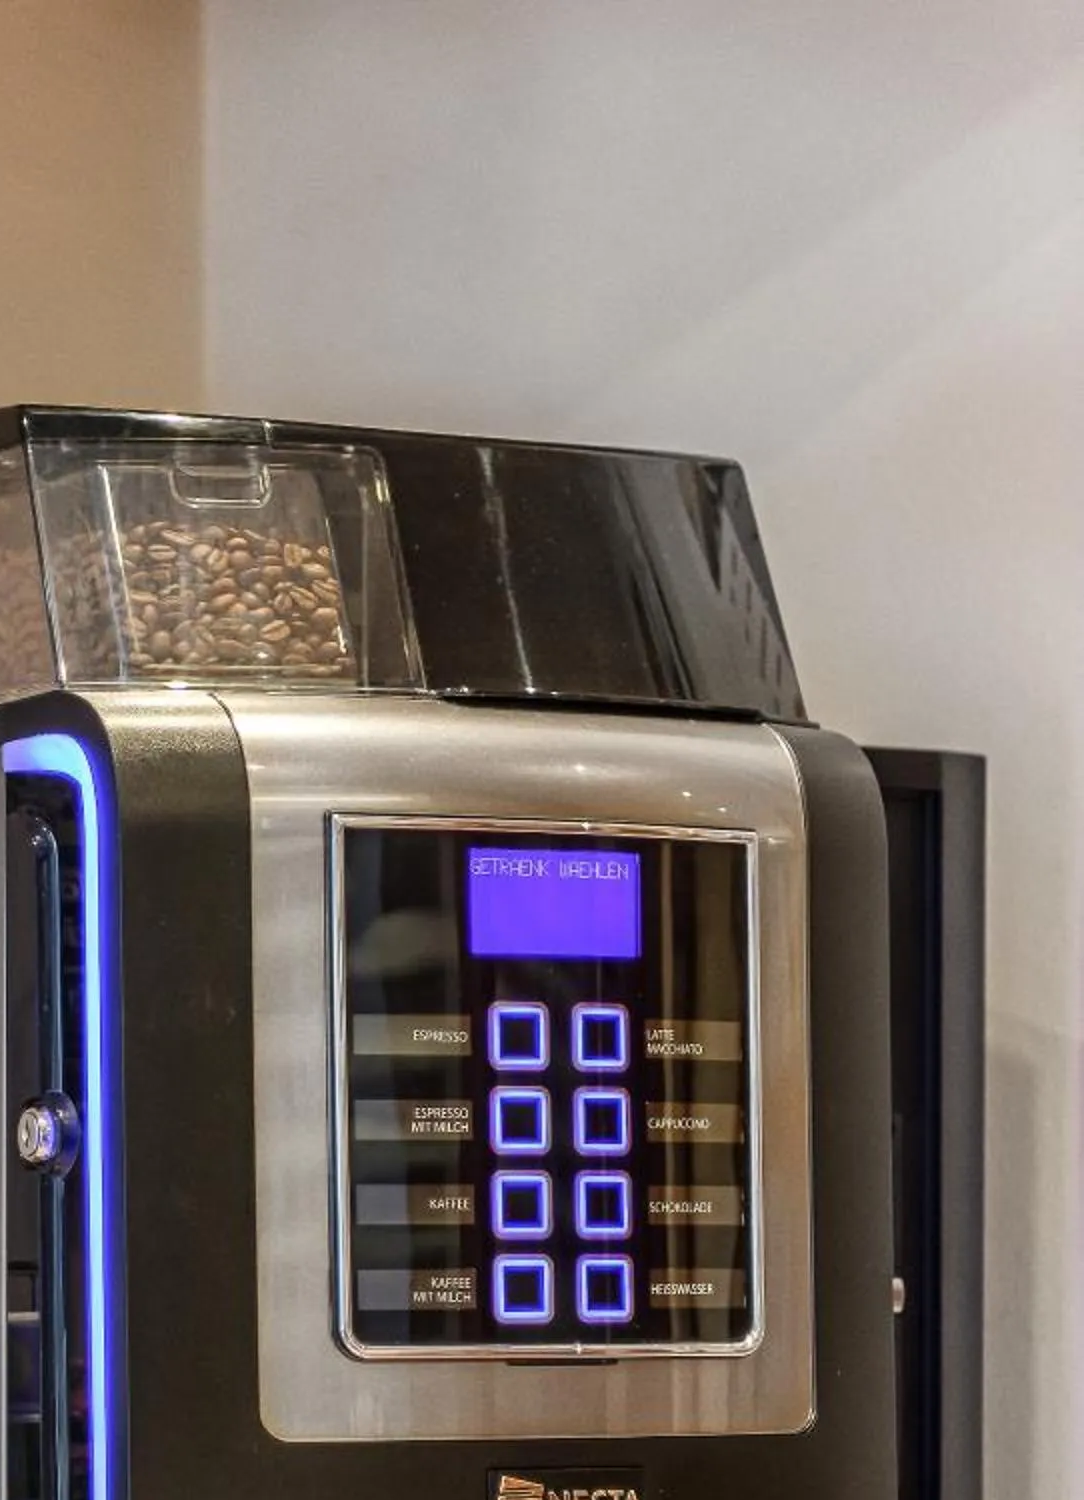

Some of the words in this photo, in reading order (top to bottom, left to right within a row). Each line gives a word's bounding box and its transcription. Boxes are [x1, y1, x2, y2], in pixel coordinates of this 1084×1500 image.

[470, 857, 548, 877] GETRAENK
[559, 861, 629, 879] WAEHLEN
[413, 1029, 469, 1043] ESPRESSO
[647, 1029, 675, 1041] LATTE
[647, 1043, 704, 1055] MACCHIATO
[415, 1107, 469, 1119] ESPRESSO
[411, 1121, 433, 1133] MIT
[434, 1121, 469, 1133] MILCH
[647, 1116, 711, 1129] CAPPUCCINO
[429, 1198, 470, 1210] KAFFEE
[649, 1201, 713, 1213] SCHOKOLADE
[431, 1277, 472, 1289] KAFFEE
[651, 1283, 715, 1295] HEISSWASSER
[413, 1291, 434, 1303] MIT
[437, 1291, 472, 1303] MILCH
